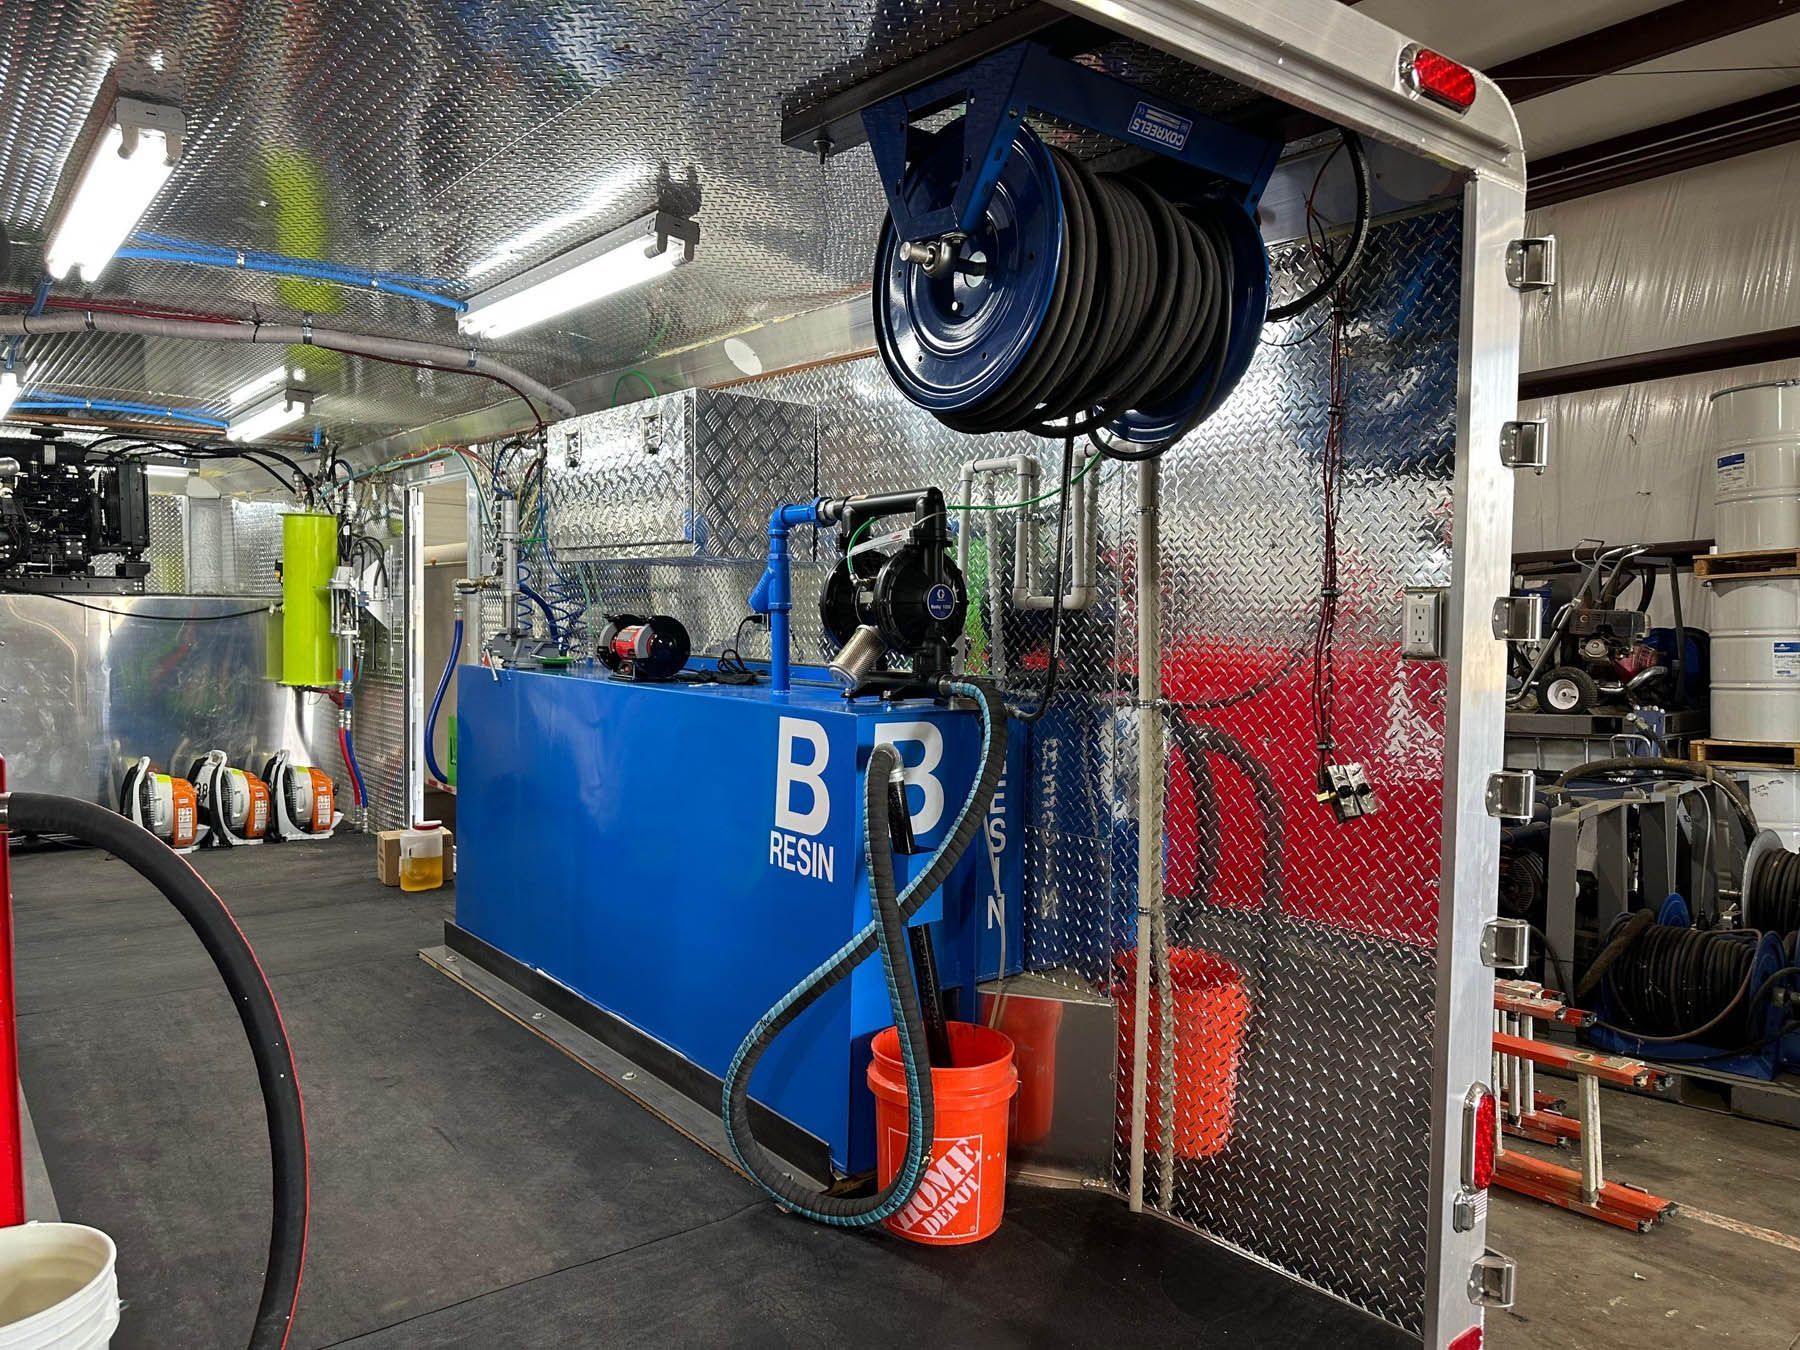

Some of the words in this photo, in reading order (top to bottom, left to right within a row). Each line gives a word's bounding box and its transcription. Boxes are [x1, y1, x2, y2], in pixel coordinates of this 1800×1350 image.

[1132, 118, 1184, 146] COXREELS
[775, 716, 829, 835] B
[874, 721, 944, 837] B
[769, 831, 834, 883] RESIN
[898, 1139, 981, 1230] HOME
[921, 1175, 979, 1236] DEPOT
